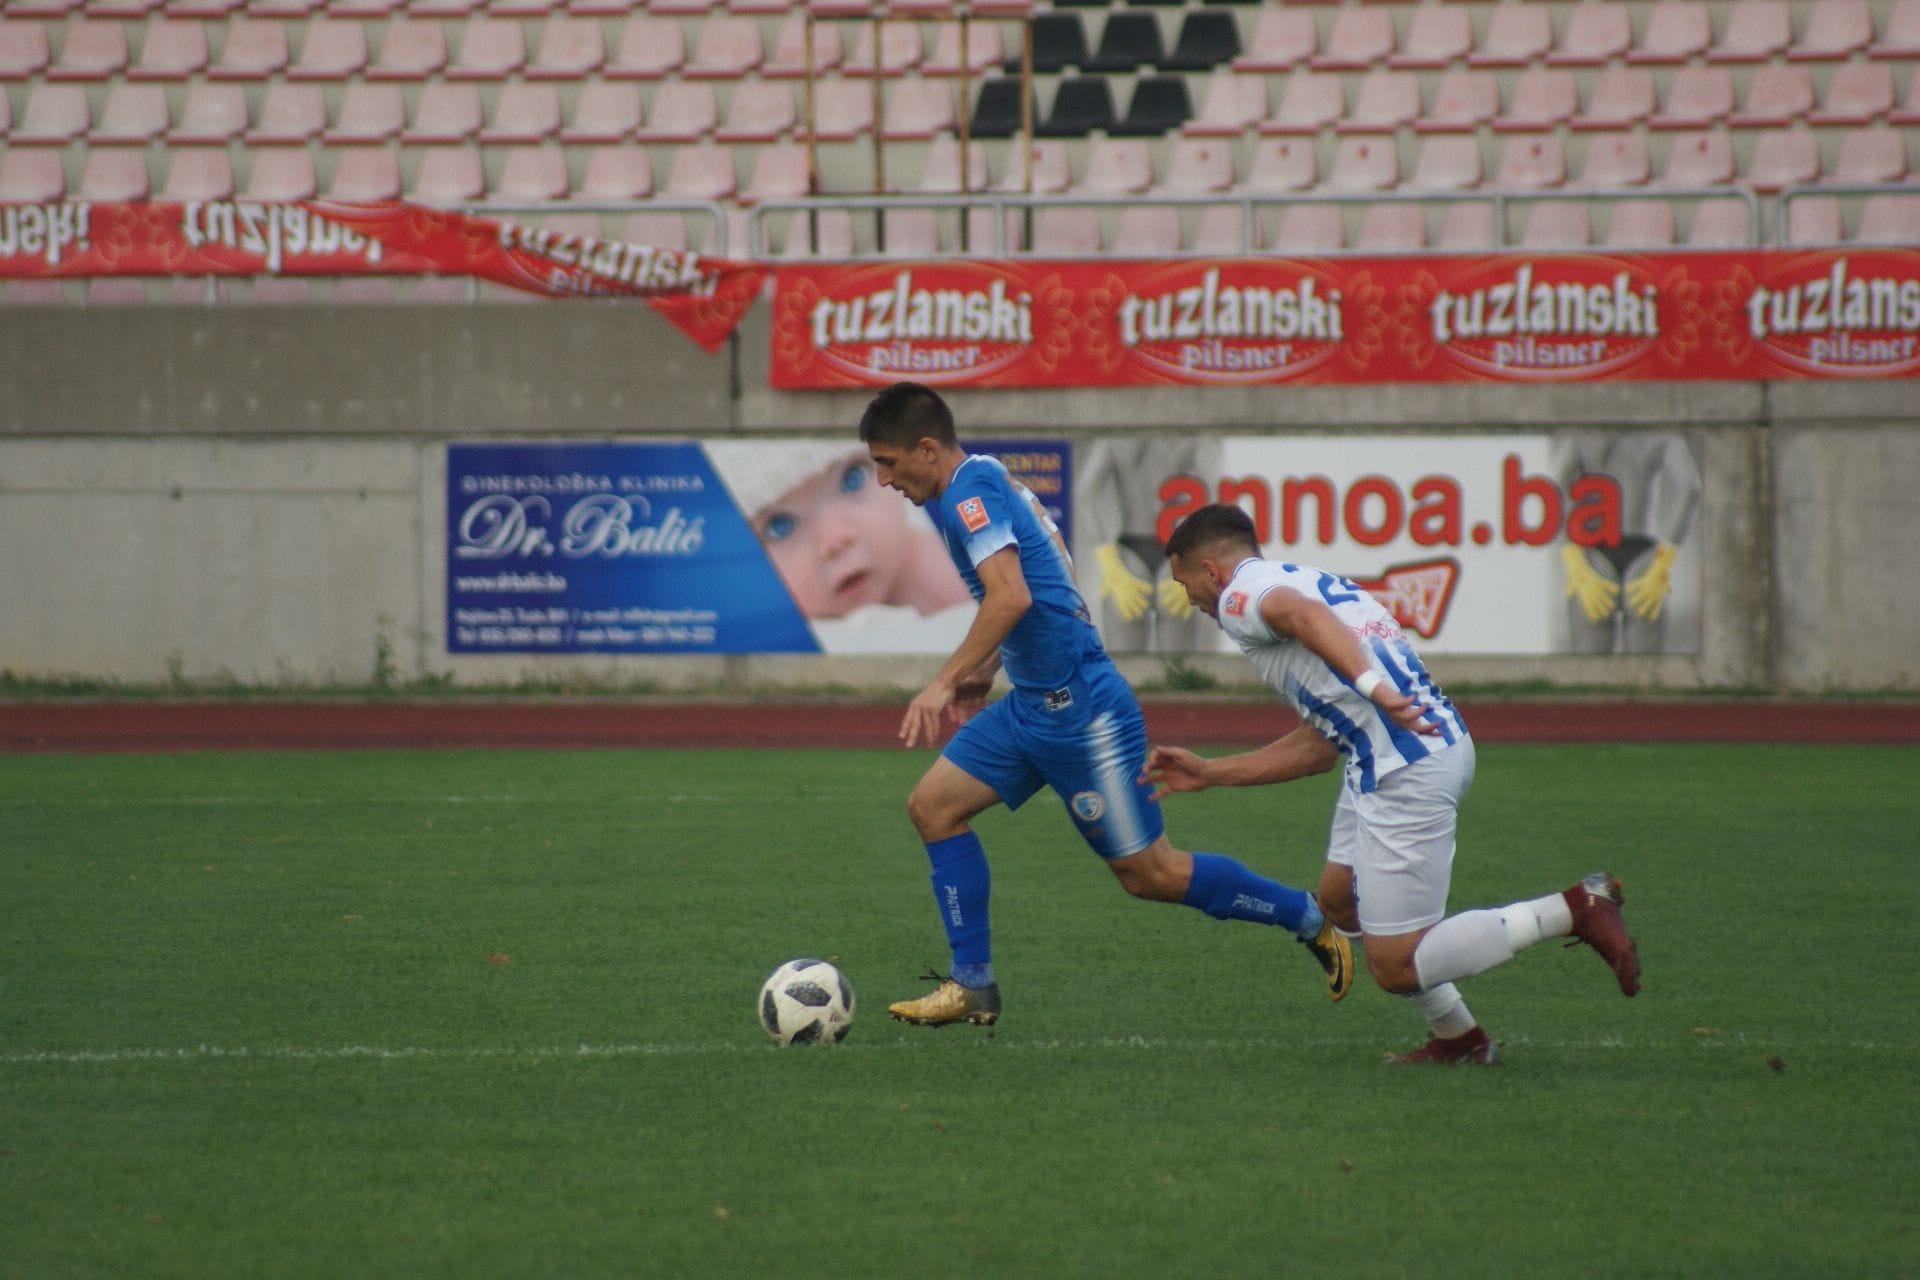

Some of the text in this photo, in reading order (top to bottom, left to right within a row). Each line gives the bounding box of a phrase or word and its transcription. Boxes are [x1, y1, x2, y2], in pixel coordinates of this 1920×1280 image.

[810, 270, 1034, 348] tuzlanski
[1117, 266, 1345, 346] tuzlanski
[1428, 261, 1659, 344] tuzlanski
[869, 342, 981, 371] pilsner
[1181, 339, 1293, 371] pilsner
[1492, 335, 1607, 368] pilsner
[1808, 331, 1917, 365] pilsner
[617, 474, 706, 492] KLINIKA
[1155, 453, 1624, 549] annoa.ba
[456, 493, 705, 560] Dr. Balić
